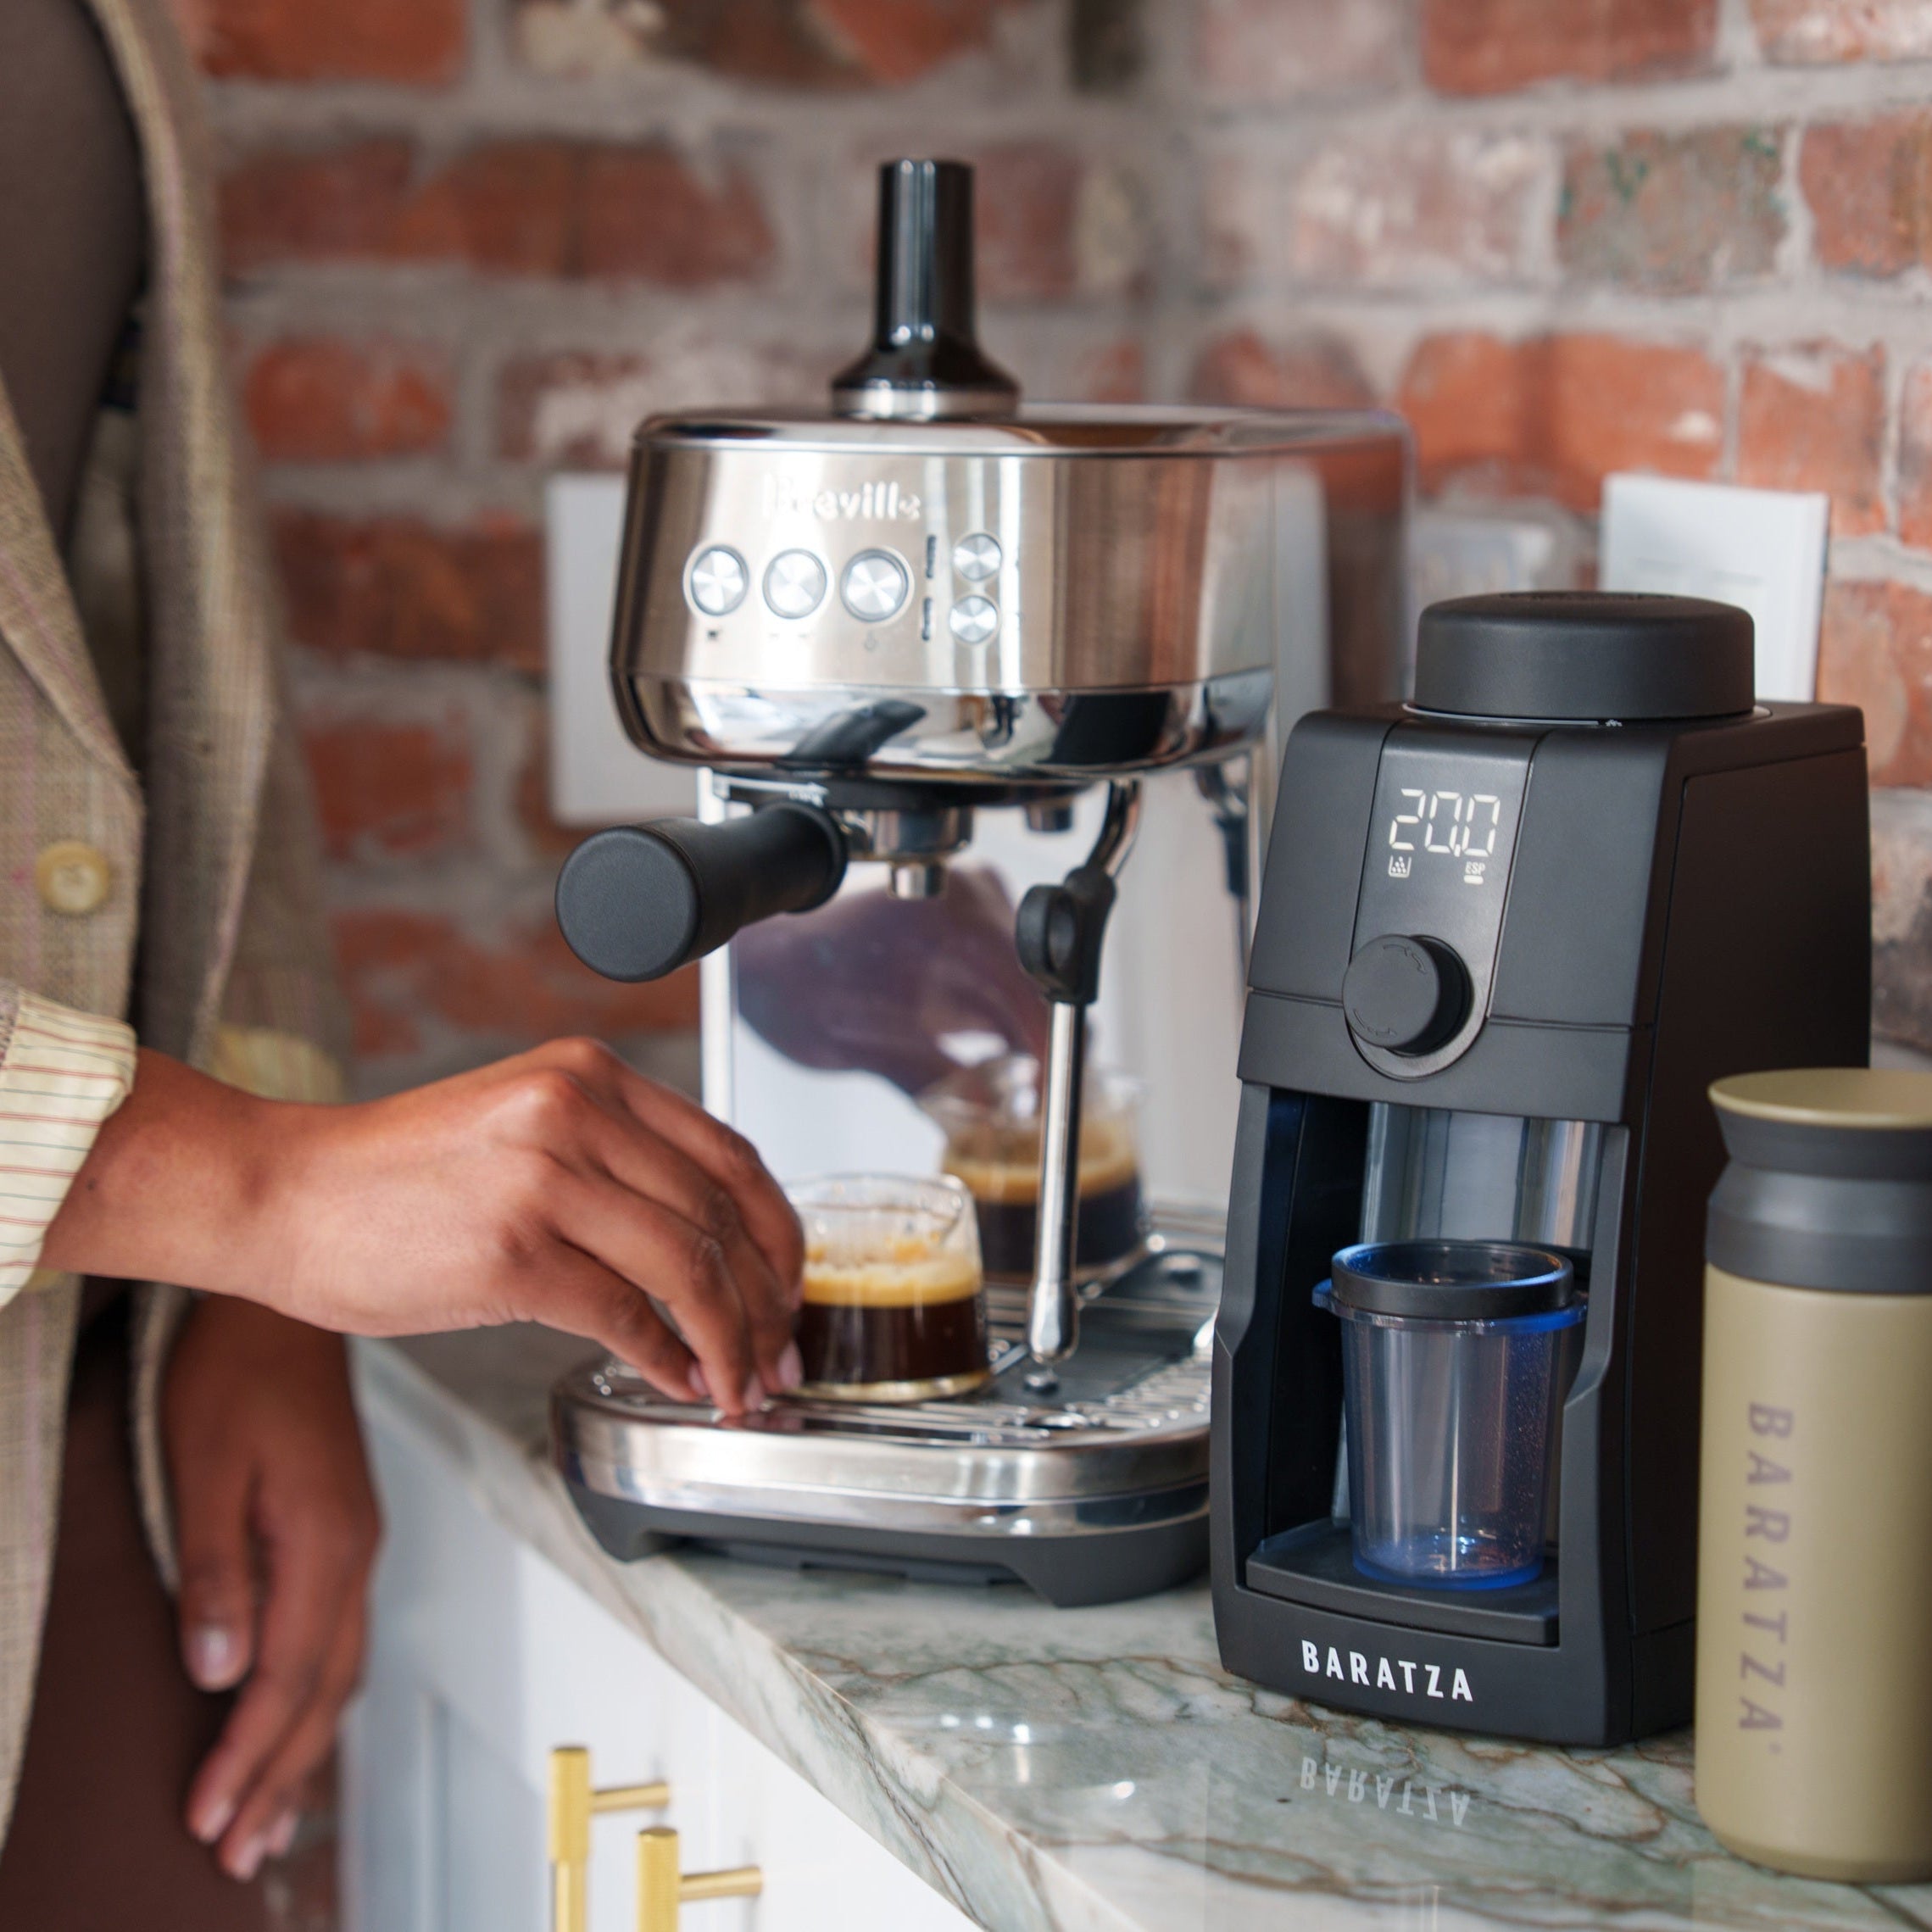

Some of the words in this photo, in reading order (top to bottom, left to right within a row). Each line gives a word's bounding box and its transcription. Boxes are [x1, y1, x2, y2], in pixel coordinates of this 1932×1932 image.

[763, 473, 921, 521] Beville
[1389, 788, 1501, 858] 20.0
[1465, 861, 1485, 875] ESP
[1739, 1401, 1795, 1731] BARATZA
[1301, 1640, 1473, 1701] BARATZA
